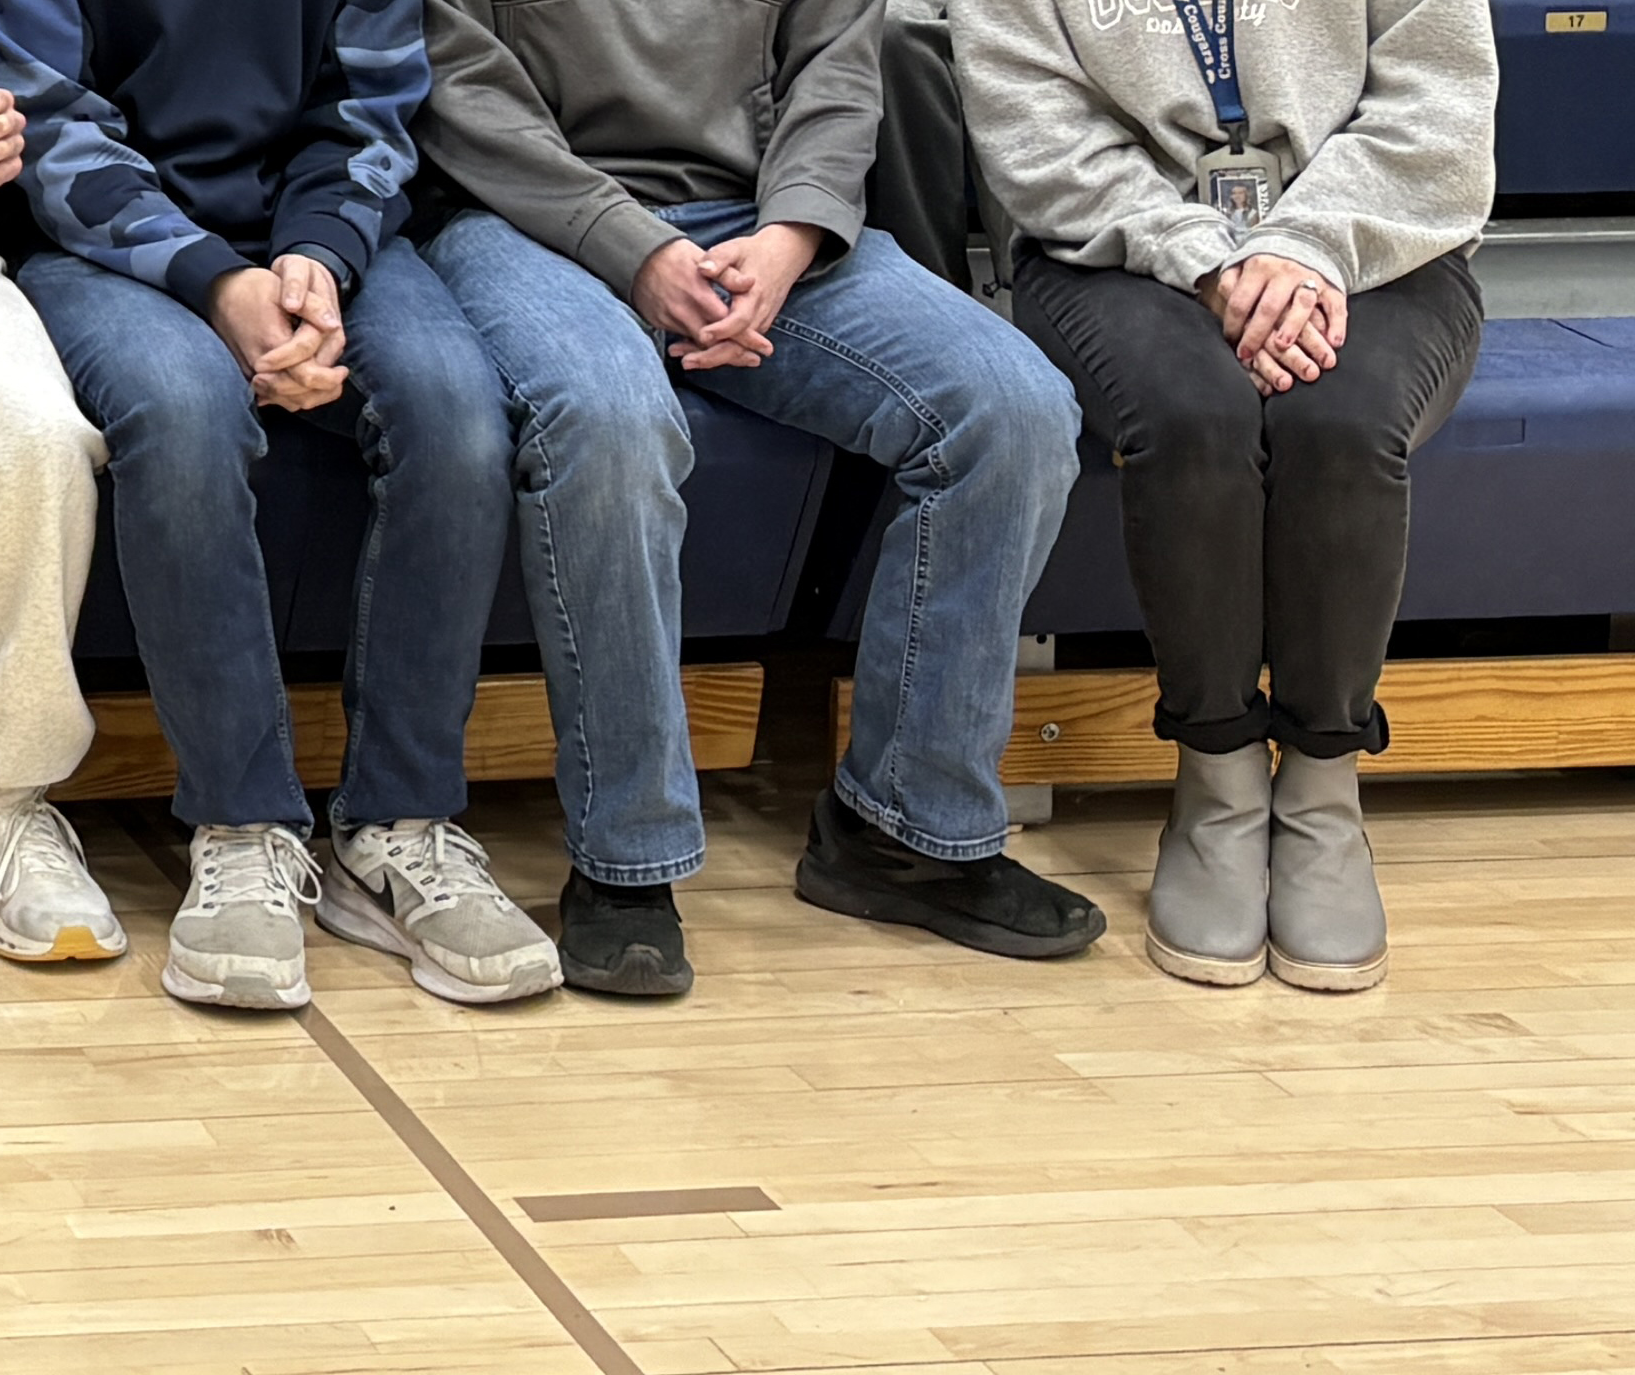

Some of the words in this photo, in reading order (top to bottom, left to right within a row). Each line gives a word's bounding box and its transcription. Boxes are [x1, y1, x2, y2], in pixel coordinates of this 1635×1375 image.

[1183, 4, 1215, 66] Cougars
[1568, 15, 1585, 28] 17
[1217, 37, 1231, 80] Cross
